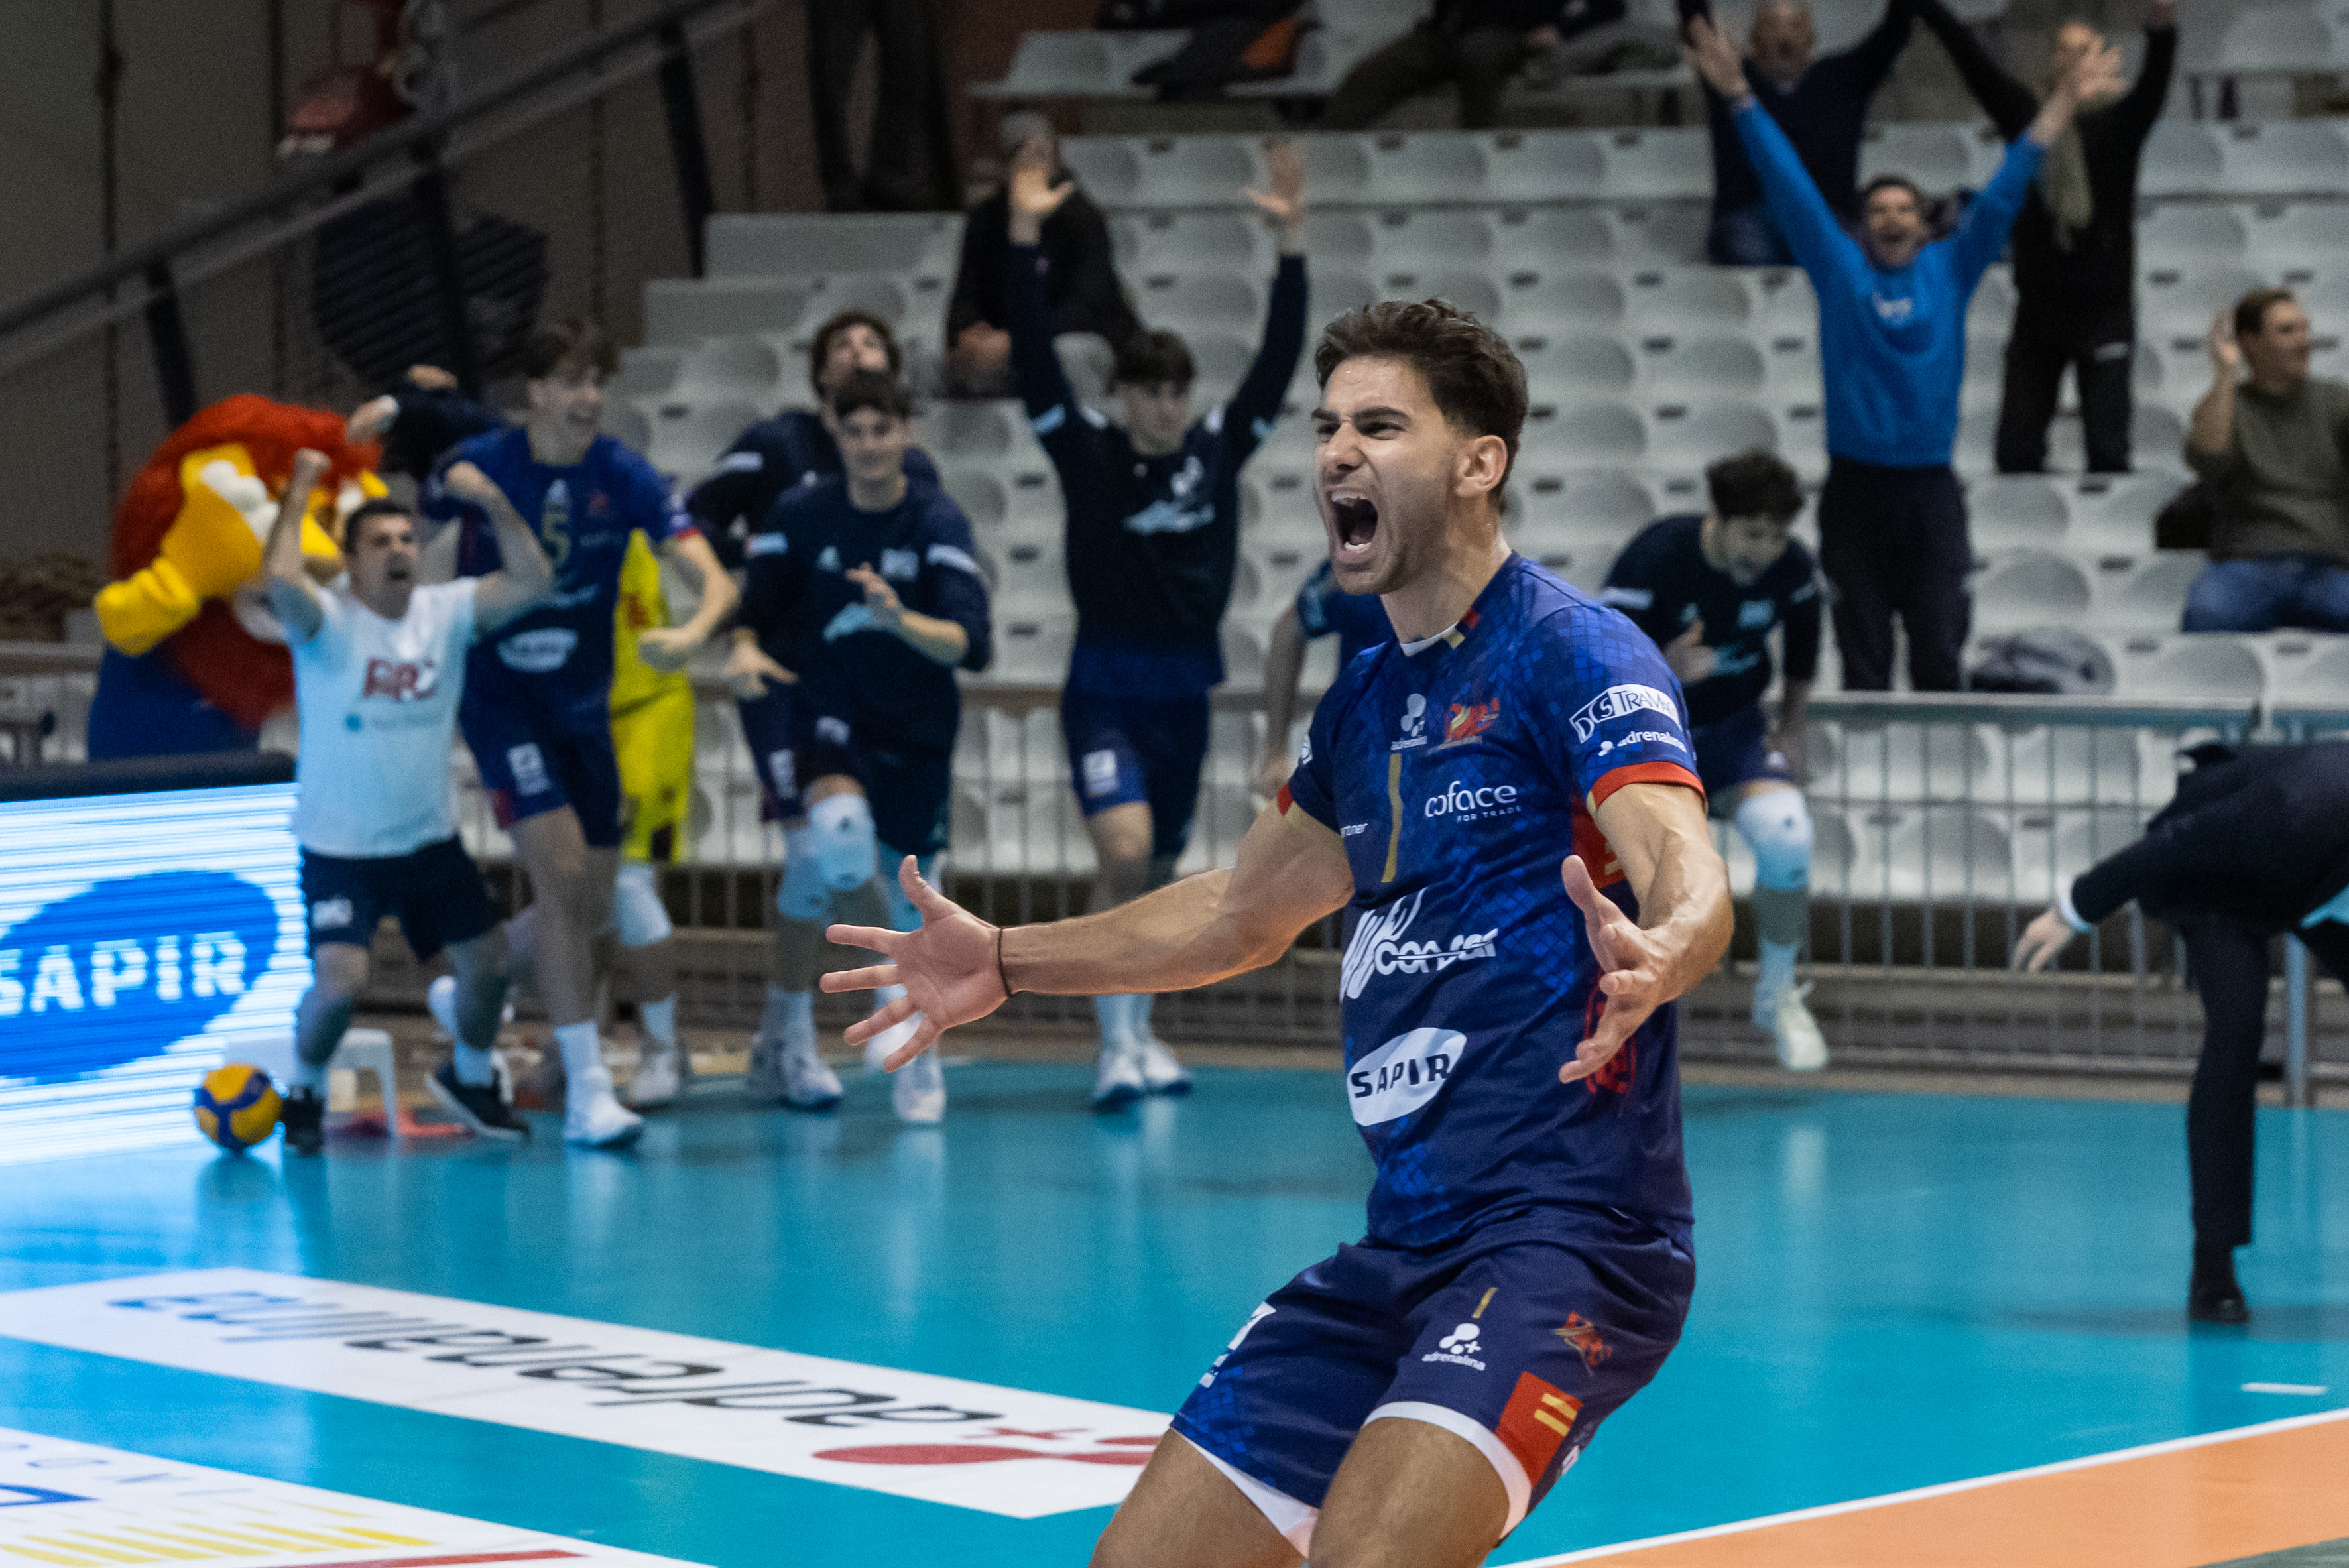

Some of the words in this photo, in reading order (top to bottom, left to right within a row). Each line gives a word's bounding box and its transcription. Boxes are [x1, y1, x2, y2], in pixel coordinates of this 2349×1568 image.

[1425, 780, 1517, 817] coface
[1457, 813, 1477, 822] FOR
[1482, 804, 1522, 818] TRADE
[1350, 1053, 1451, 1099] SAPIR
